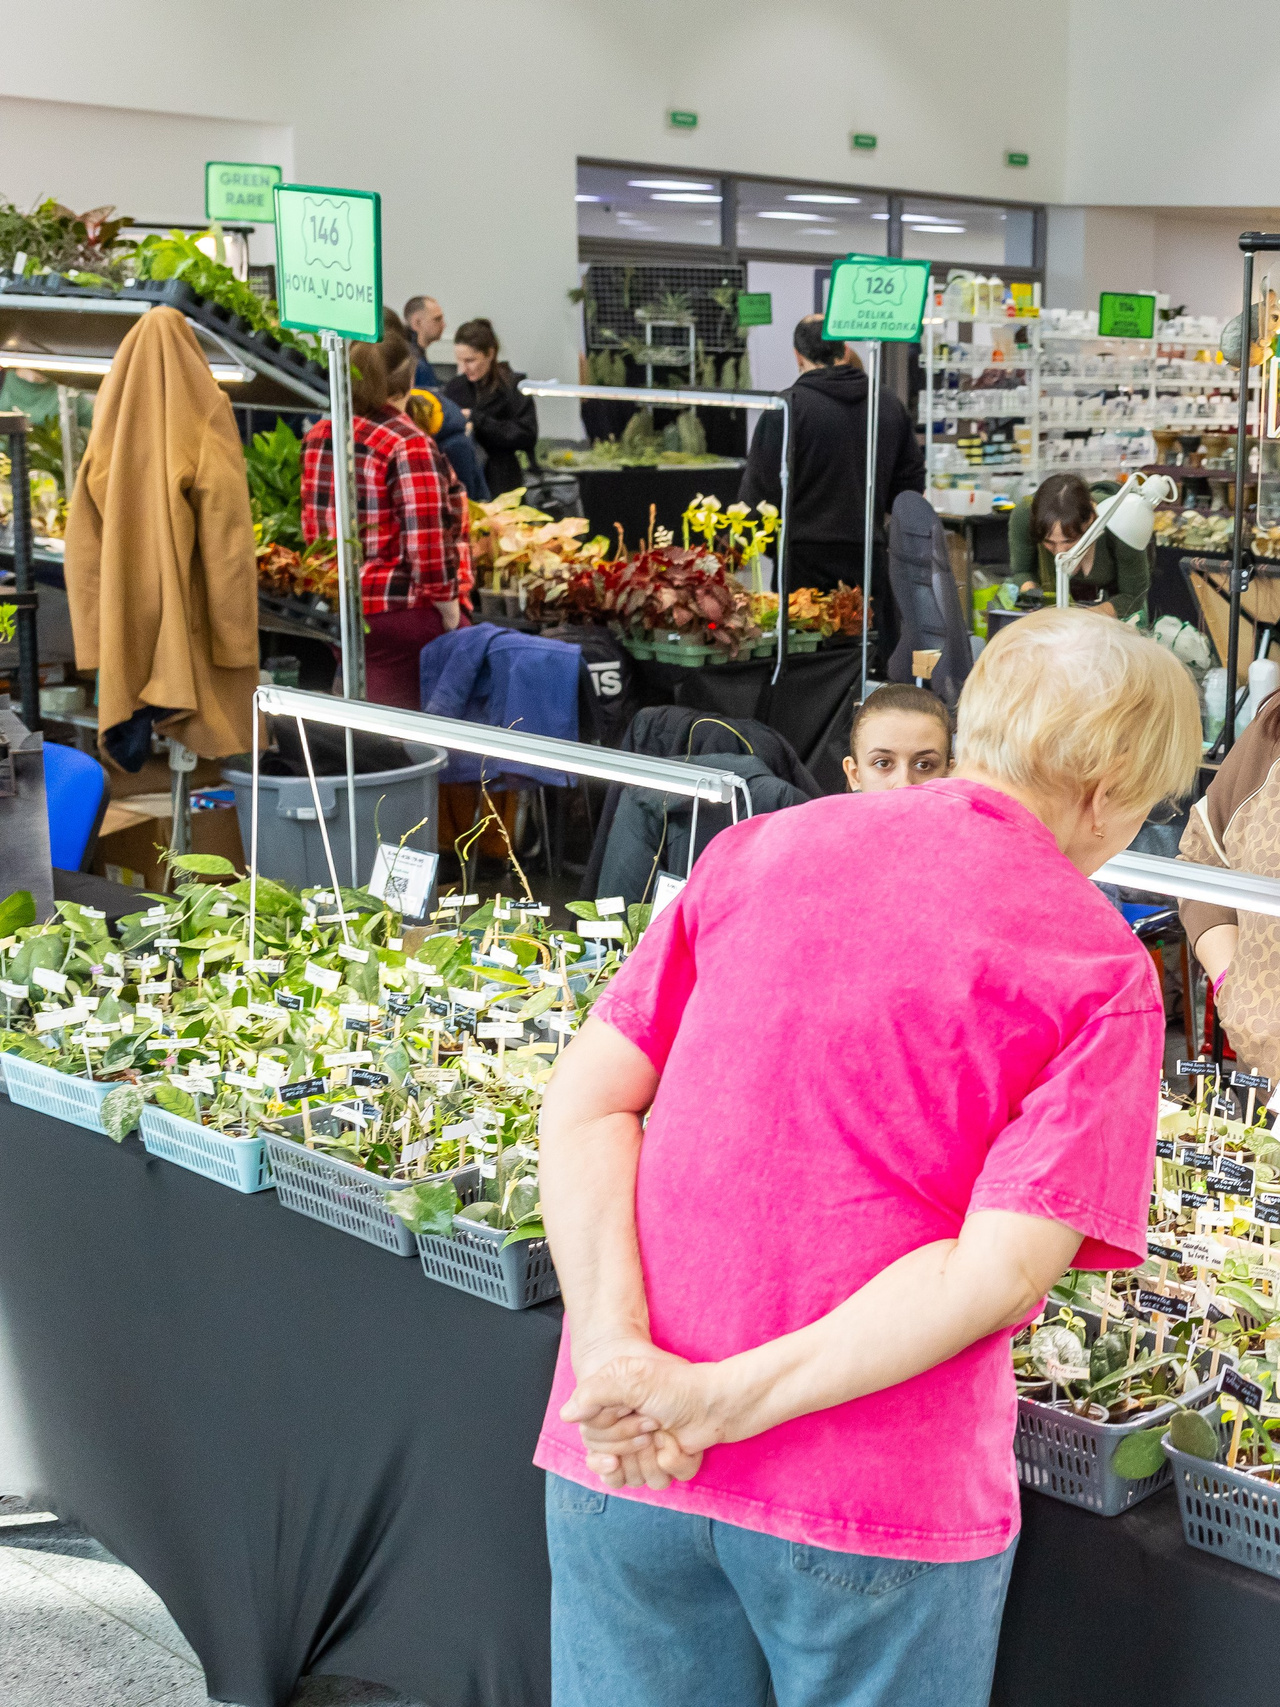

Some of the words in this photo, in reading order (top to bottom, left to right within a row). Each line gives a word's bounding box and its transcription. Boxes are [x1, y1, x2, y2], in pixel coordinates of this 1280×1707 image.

[219, 171, 271, 187] GREEN
[225, 191, 265, 207] RARE
[309, 215, 340, 246] 146
[866, 277, 894, 294] 126
[880, 321, 917, 331] ПОЛКА
